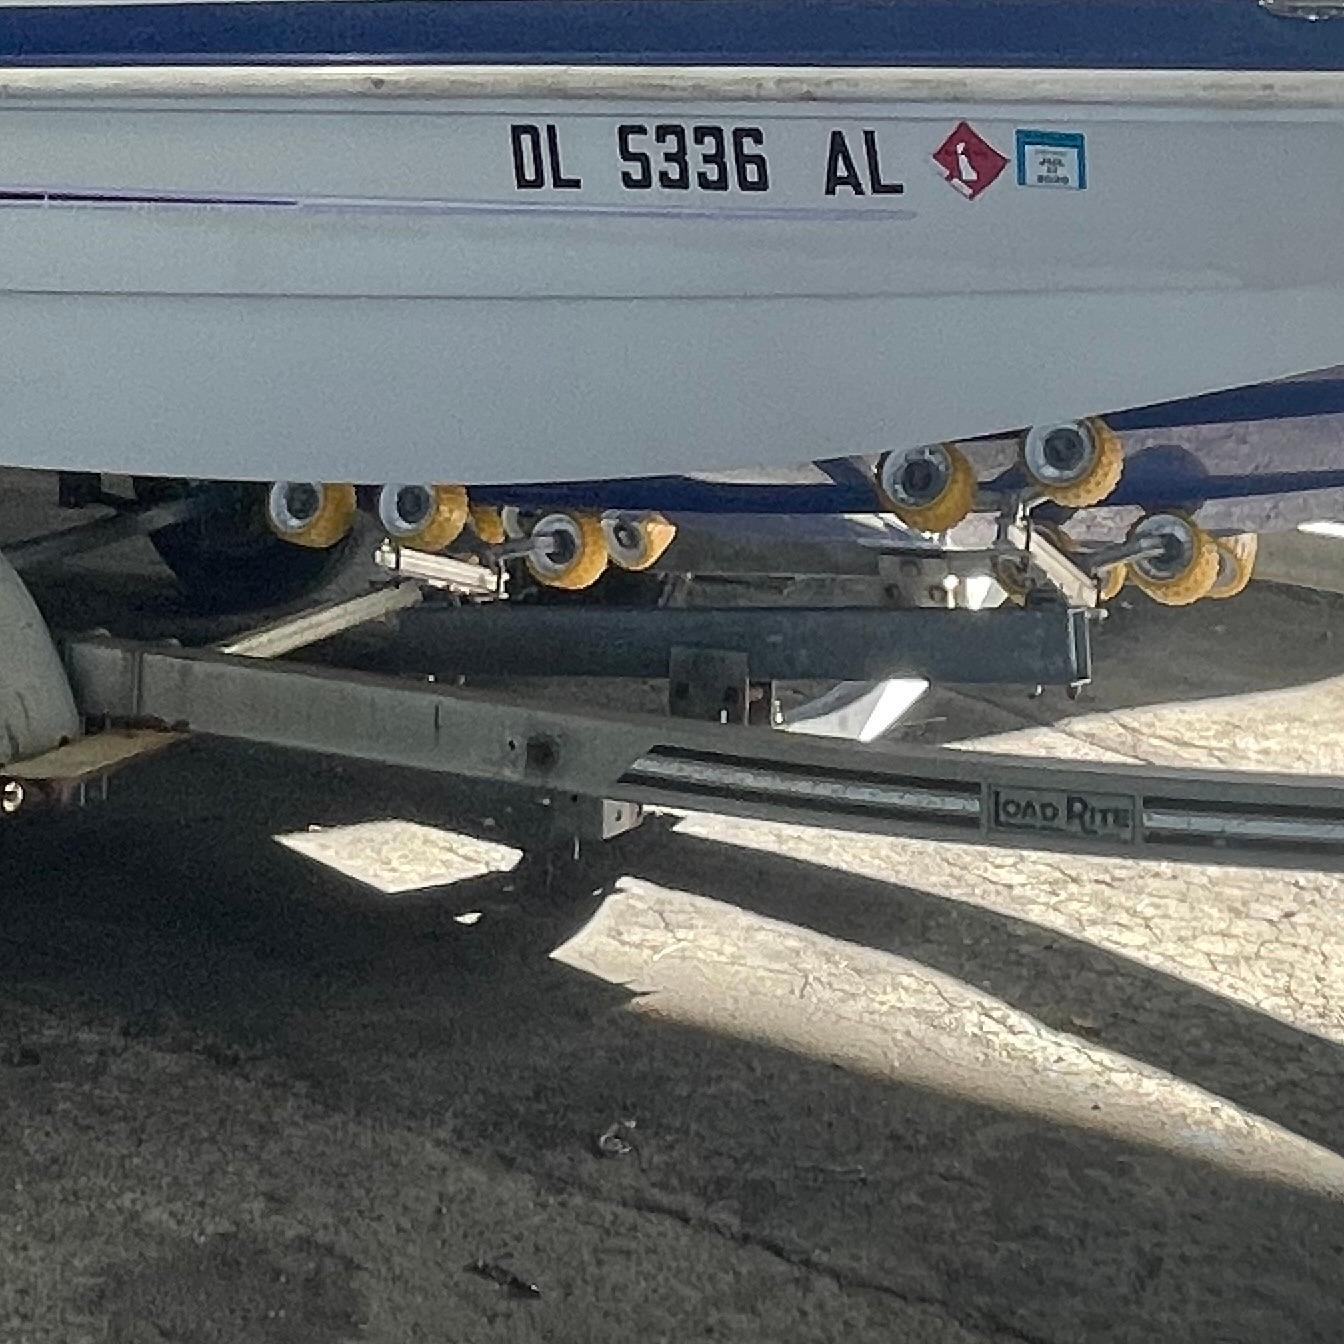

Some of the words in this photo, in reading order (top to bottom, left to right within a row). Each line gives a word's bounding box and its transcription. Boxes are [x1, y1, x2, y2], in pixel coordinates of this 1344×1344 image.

[510, 124, 582, 190] DL
[617, 123, 771, 192] 5336
[824, 129, 905, 196] AL
